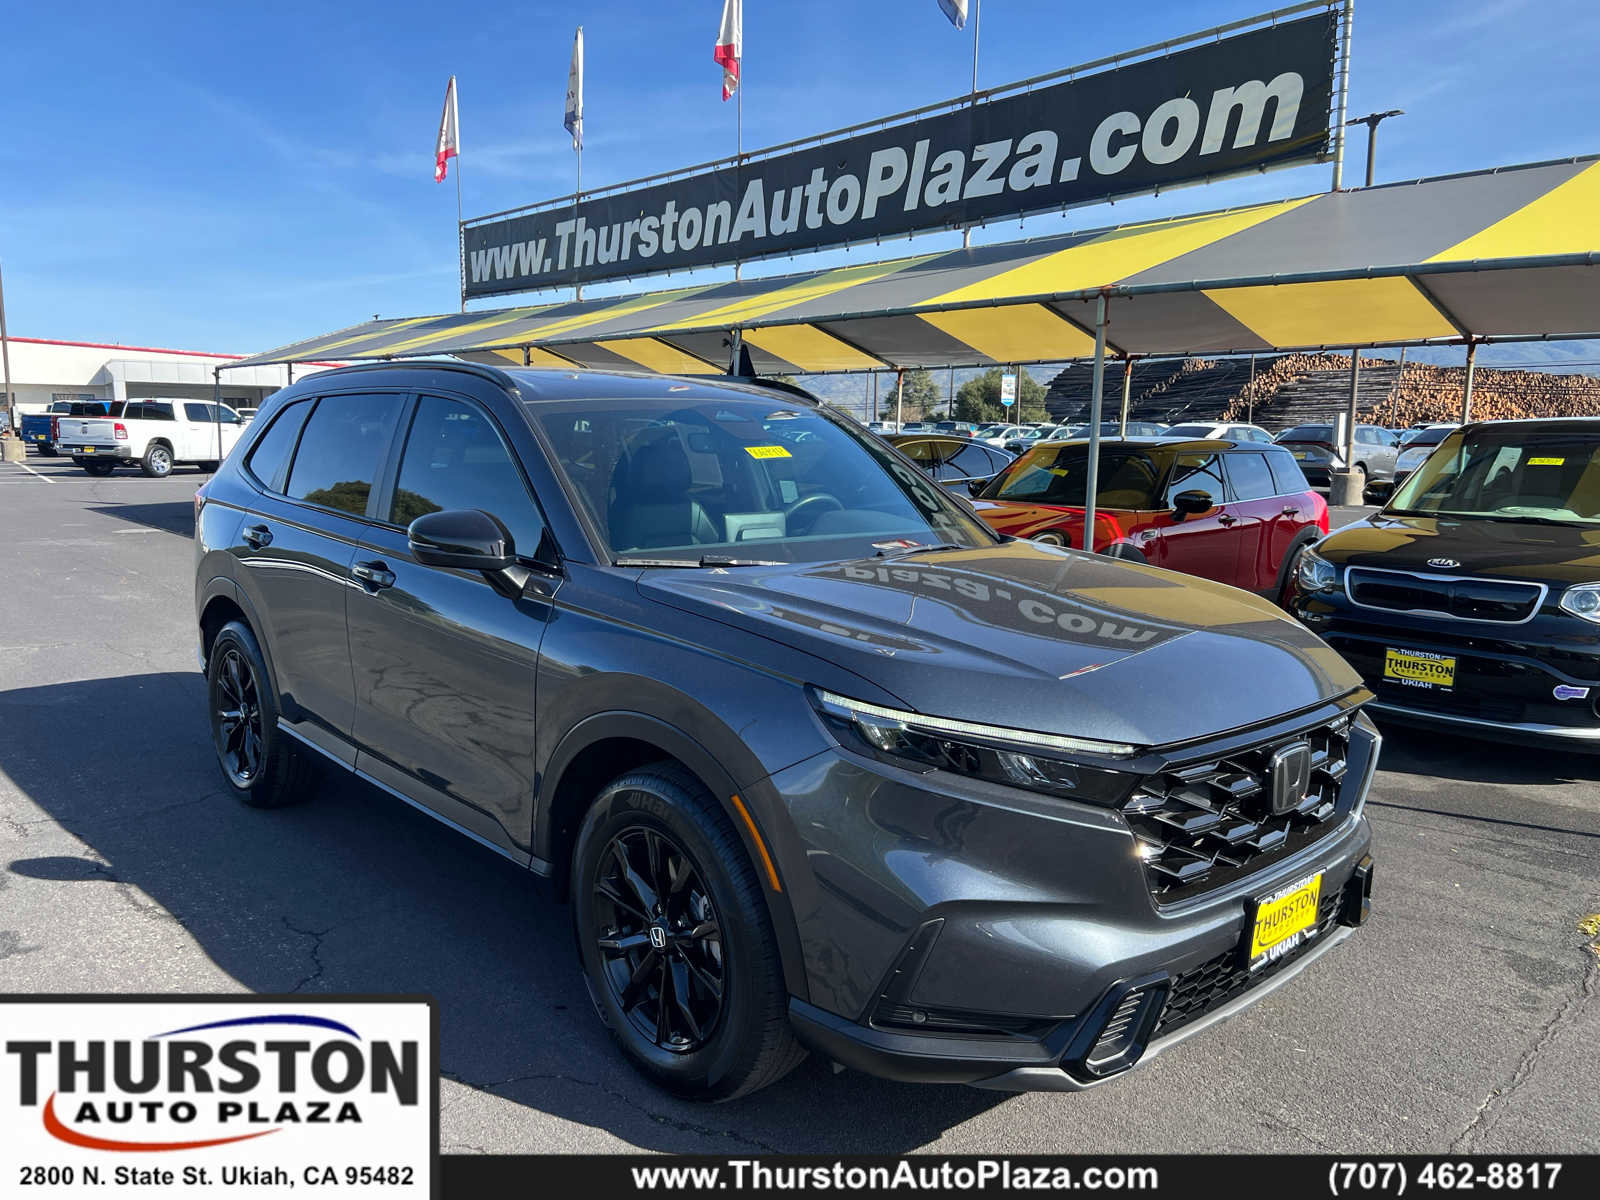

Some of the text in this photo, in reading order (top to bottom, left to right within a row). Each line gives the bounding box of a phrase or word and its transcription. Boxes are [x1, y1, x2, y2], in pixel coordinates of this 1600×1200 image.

[470, 71, 1305, 283] www.ThurstonAutoPlaza.com
[1400, 648, 1442, 660] THURSTON
[1387, 658, 1454, 678] THURSTON
[1401, 678, 1433, 689] UKIAH
[1255, 887, 1318, 940] THURSTON
[1269, 931, 1300, 961] UKIAH
